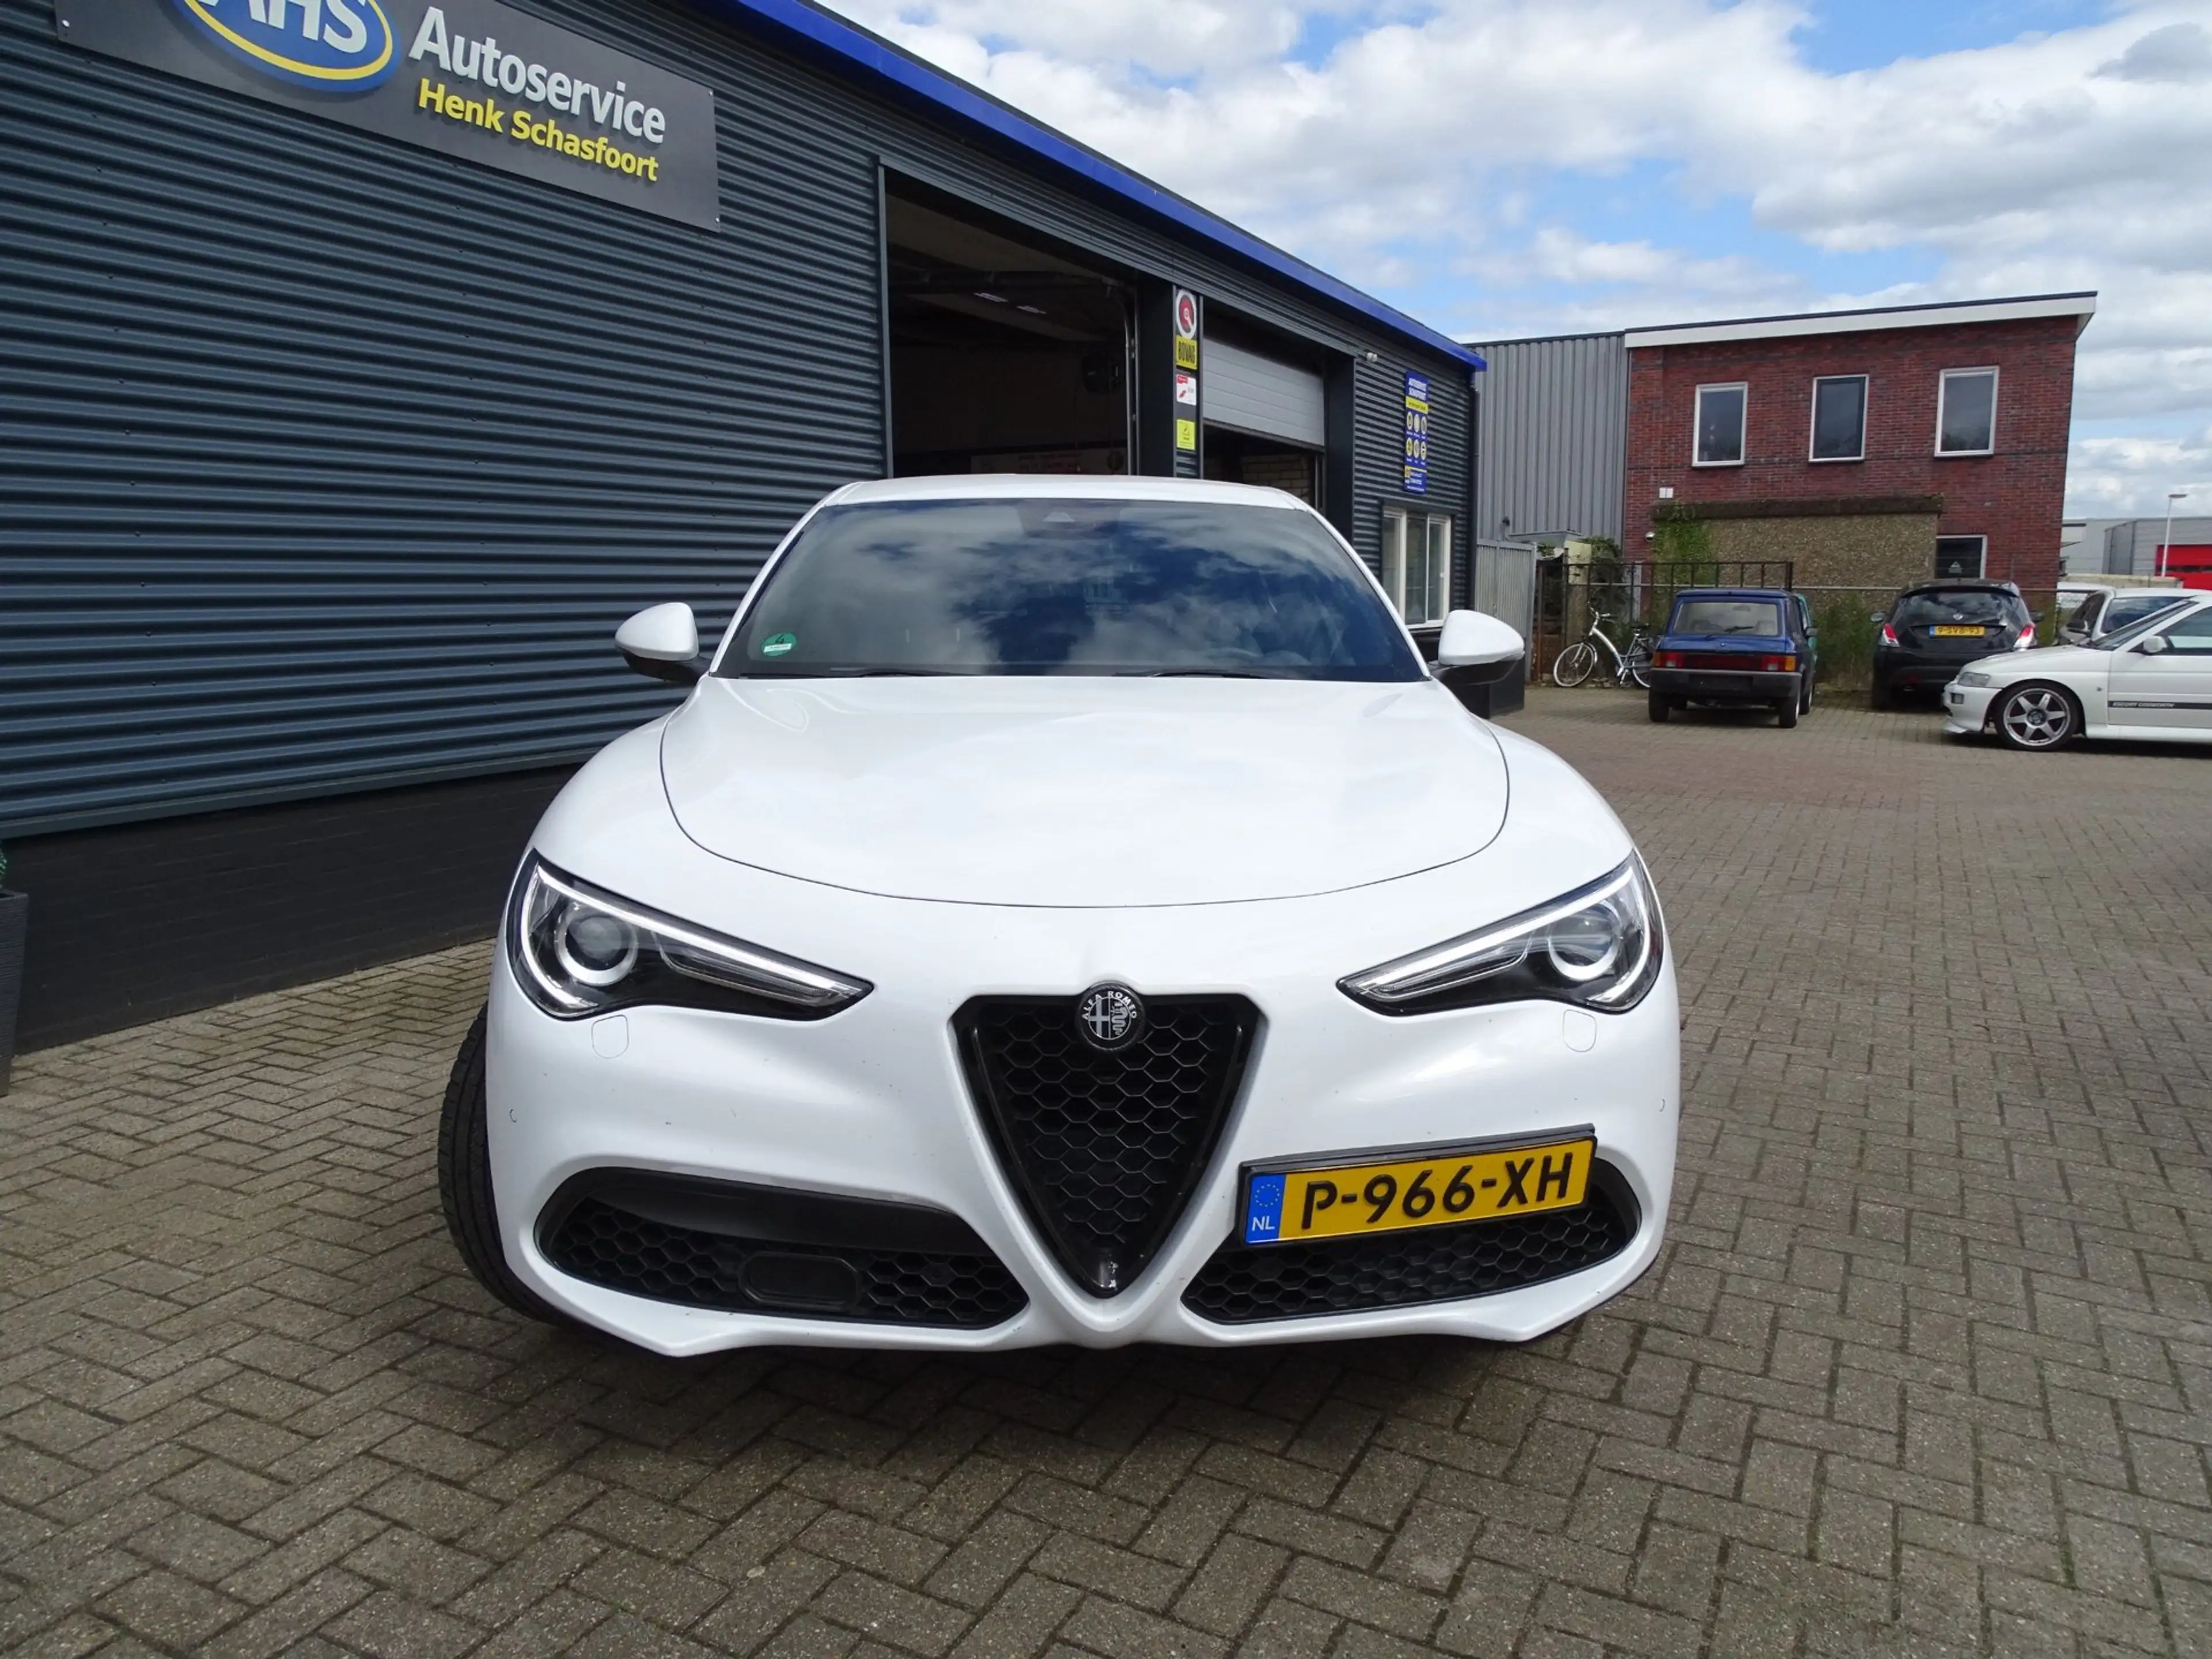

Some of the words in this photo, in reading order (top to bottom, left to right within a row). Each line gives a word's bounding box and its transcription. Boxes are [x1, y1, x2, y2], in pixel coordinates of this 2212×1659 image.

[408, 6, 666, 143] Autoservice
[419, 78, 505, 133] Henk
[511, 109, 659, 181] Schasfoort
[1178, 341, 1196, 364] BOVAG
[1082, 994, 1102, 1020] ALFA
[1107, 990, 1138, 1019] ROMEO
[1301, 1152, 1573, 1229] P-966-XH
[1252, 1215, 1275, 1232] NL
